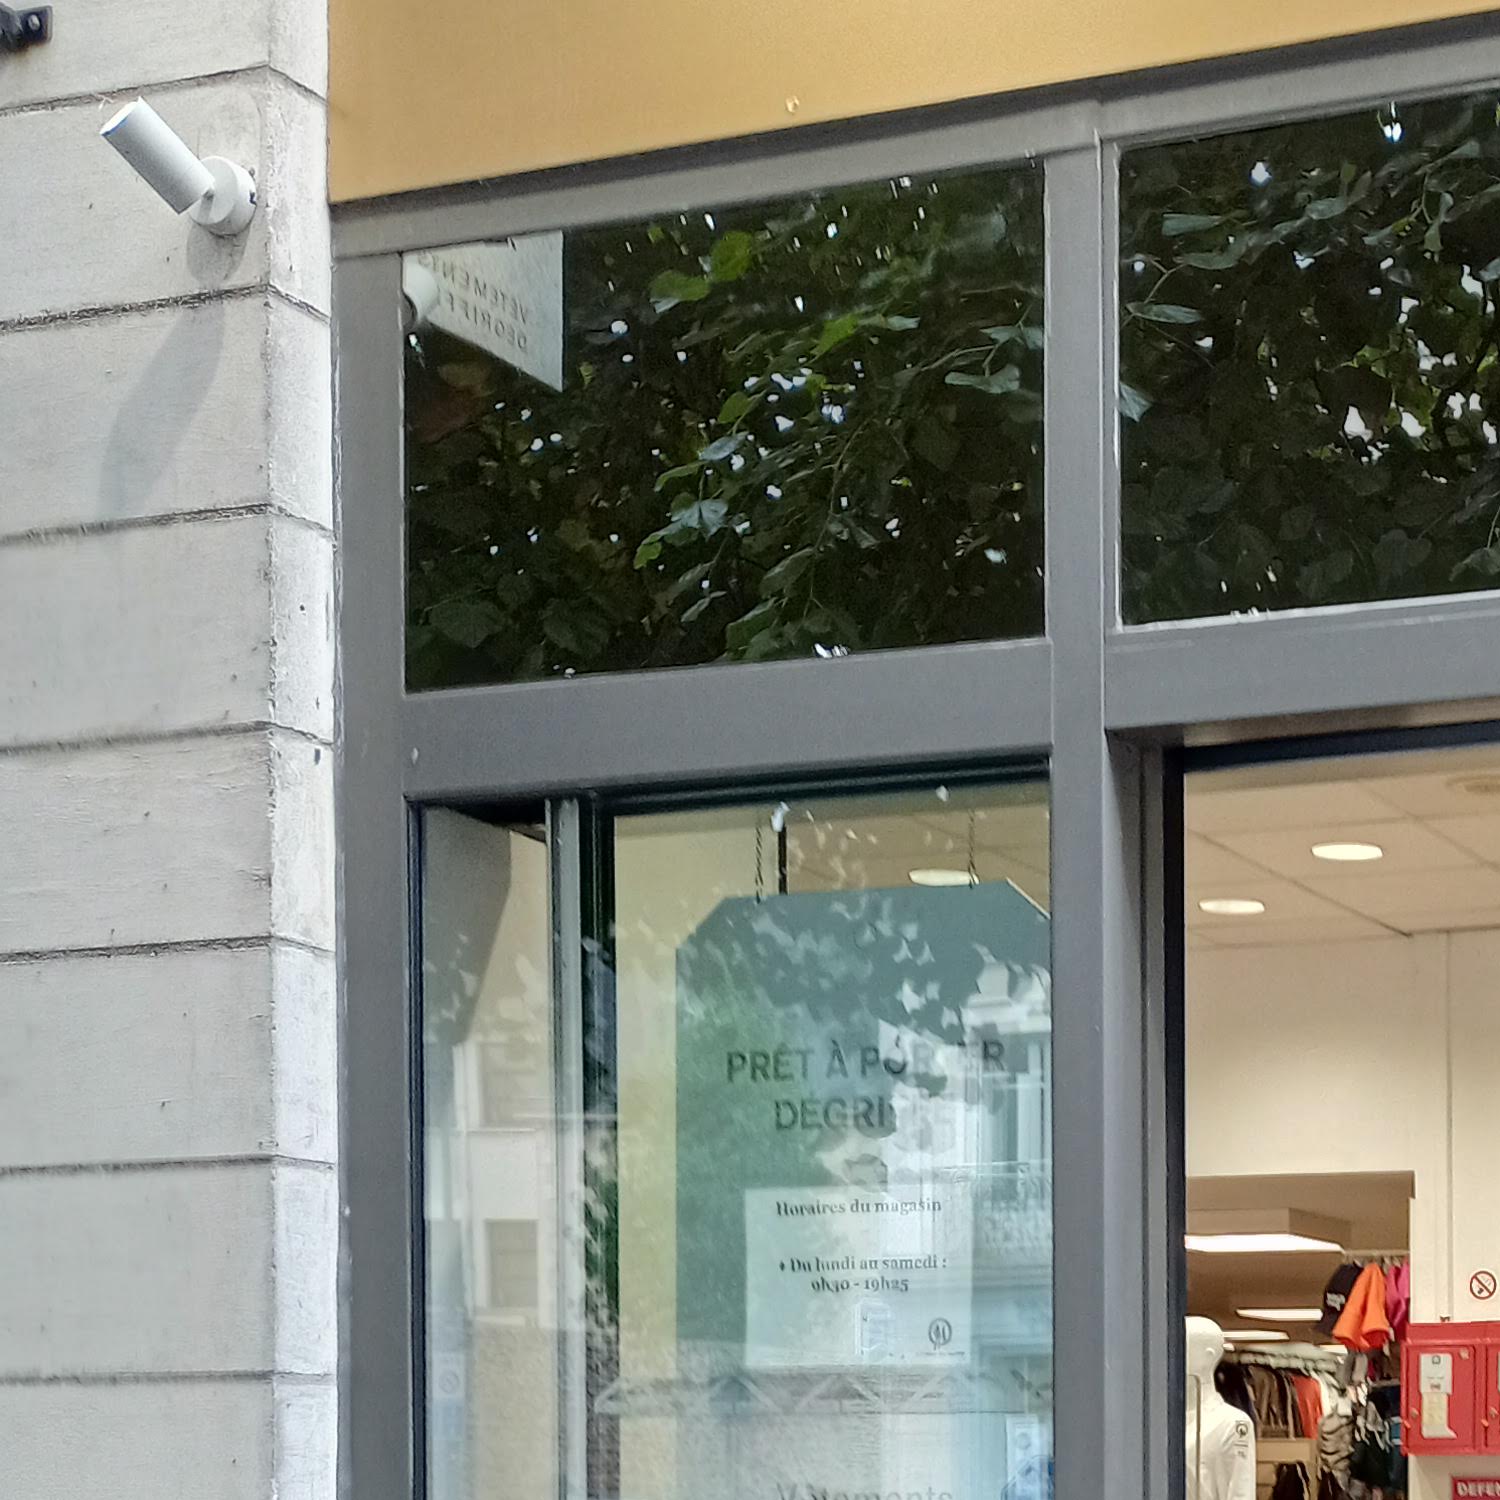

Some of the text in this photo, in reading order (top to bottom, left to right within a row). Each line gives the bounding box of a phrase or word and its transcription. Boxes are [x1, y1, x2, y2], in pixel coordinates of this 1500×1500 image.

[826, 1038, 848, 1079] À
[776, 1198, 942, 1217] Horaires du magasin
[790, 1258, 812, 1273] Du
[815, 1256, 855, 1272] lundi
[860, 1259, 878, 1271] au
[883, 1254, 938, 1270] samedi
